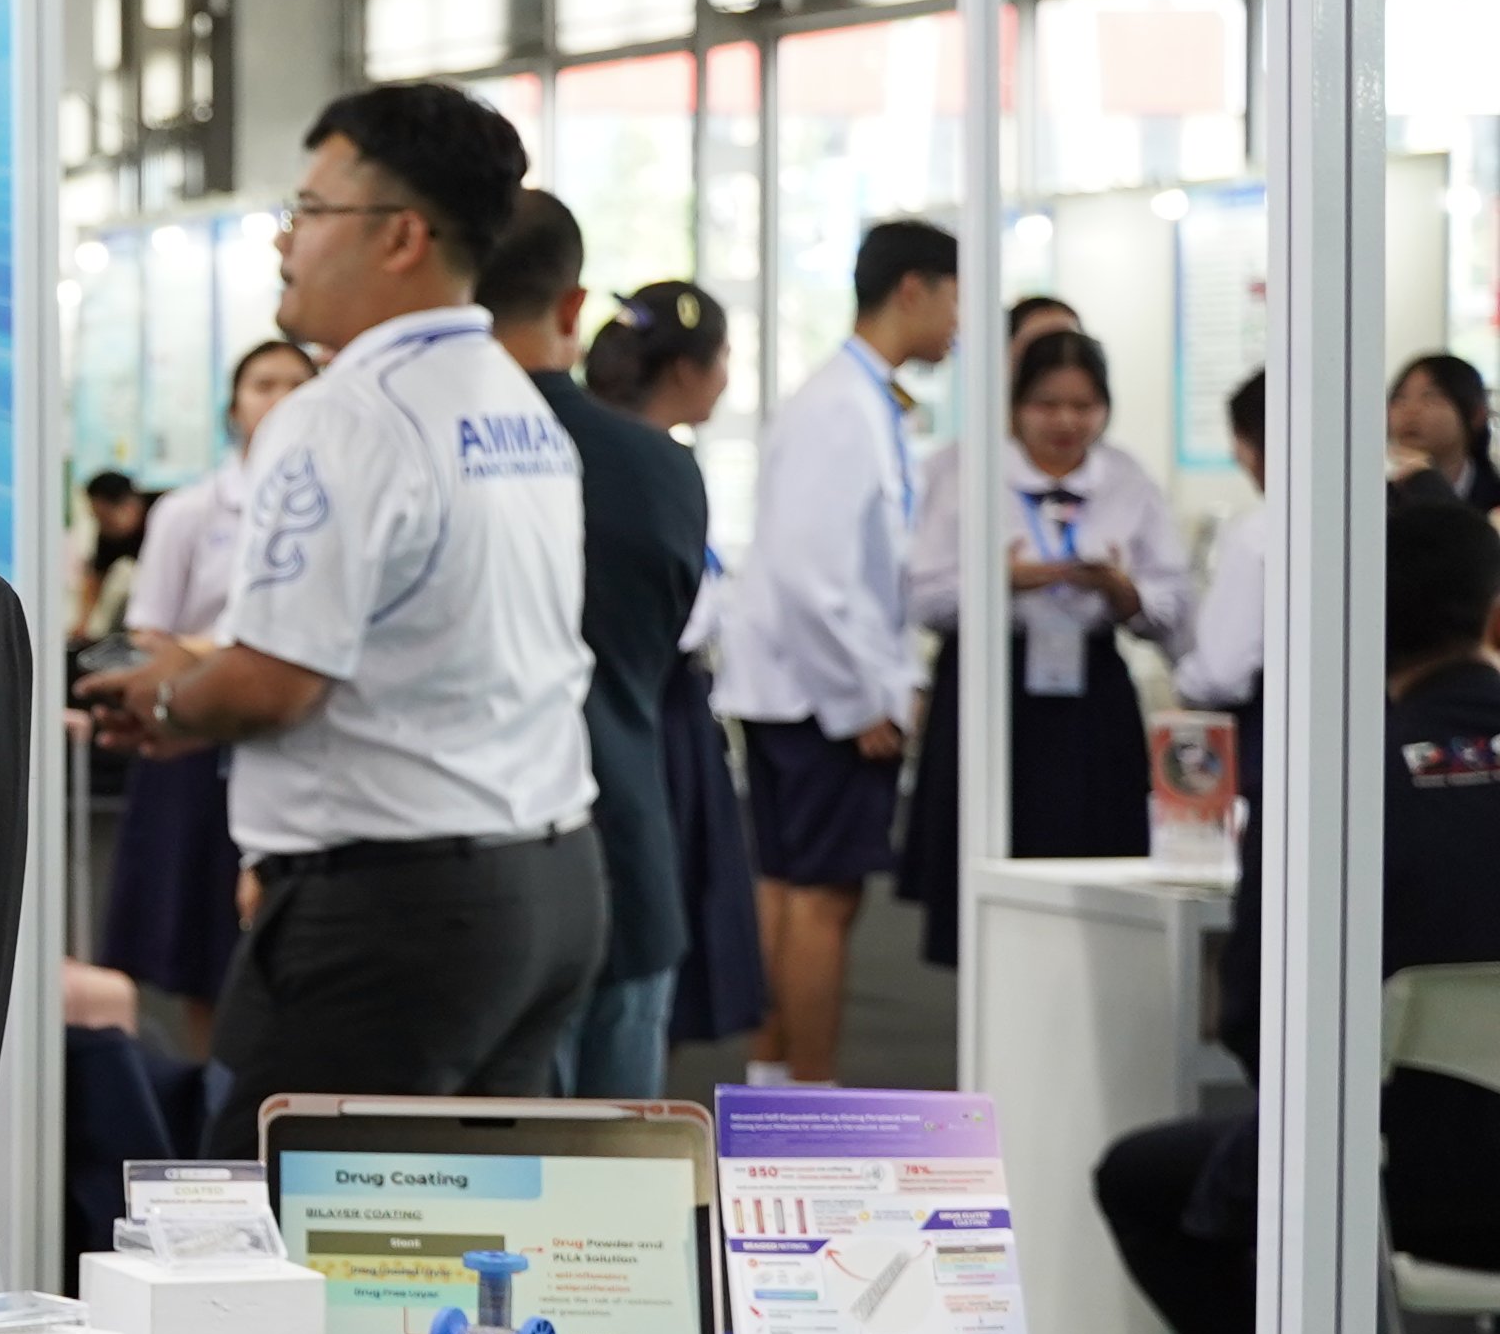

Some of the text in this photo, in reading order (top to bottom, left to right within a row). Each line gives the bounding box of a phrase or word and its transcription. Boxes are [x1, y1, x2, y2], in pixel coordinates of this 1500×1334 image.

[335, 1170, 469, 1189] Drug Coating
[364, 1209, 422, 1220] COATING
[552, 1238, 584, 1250] Drug
